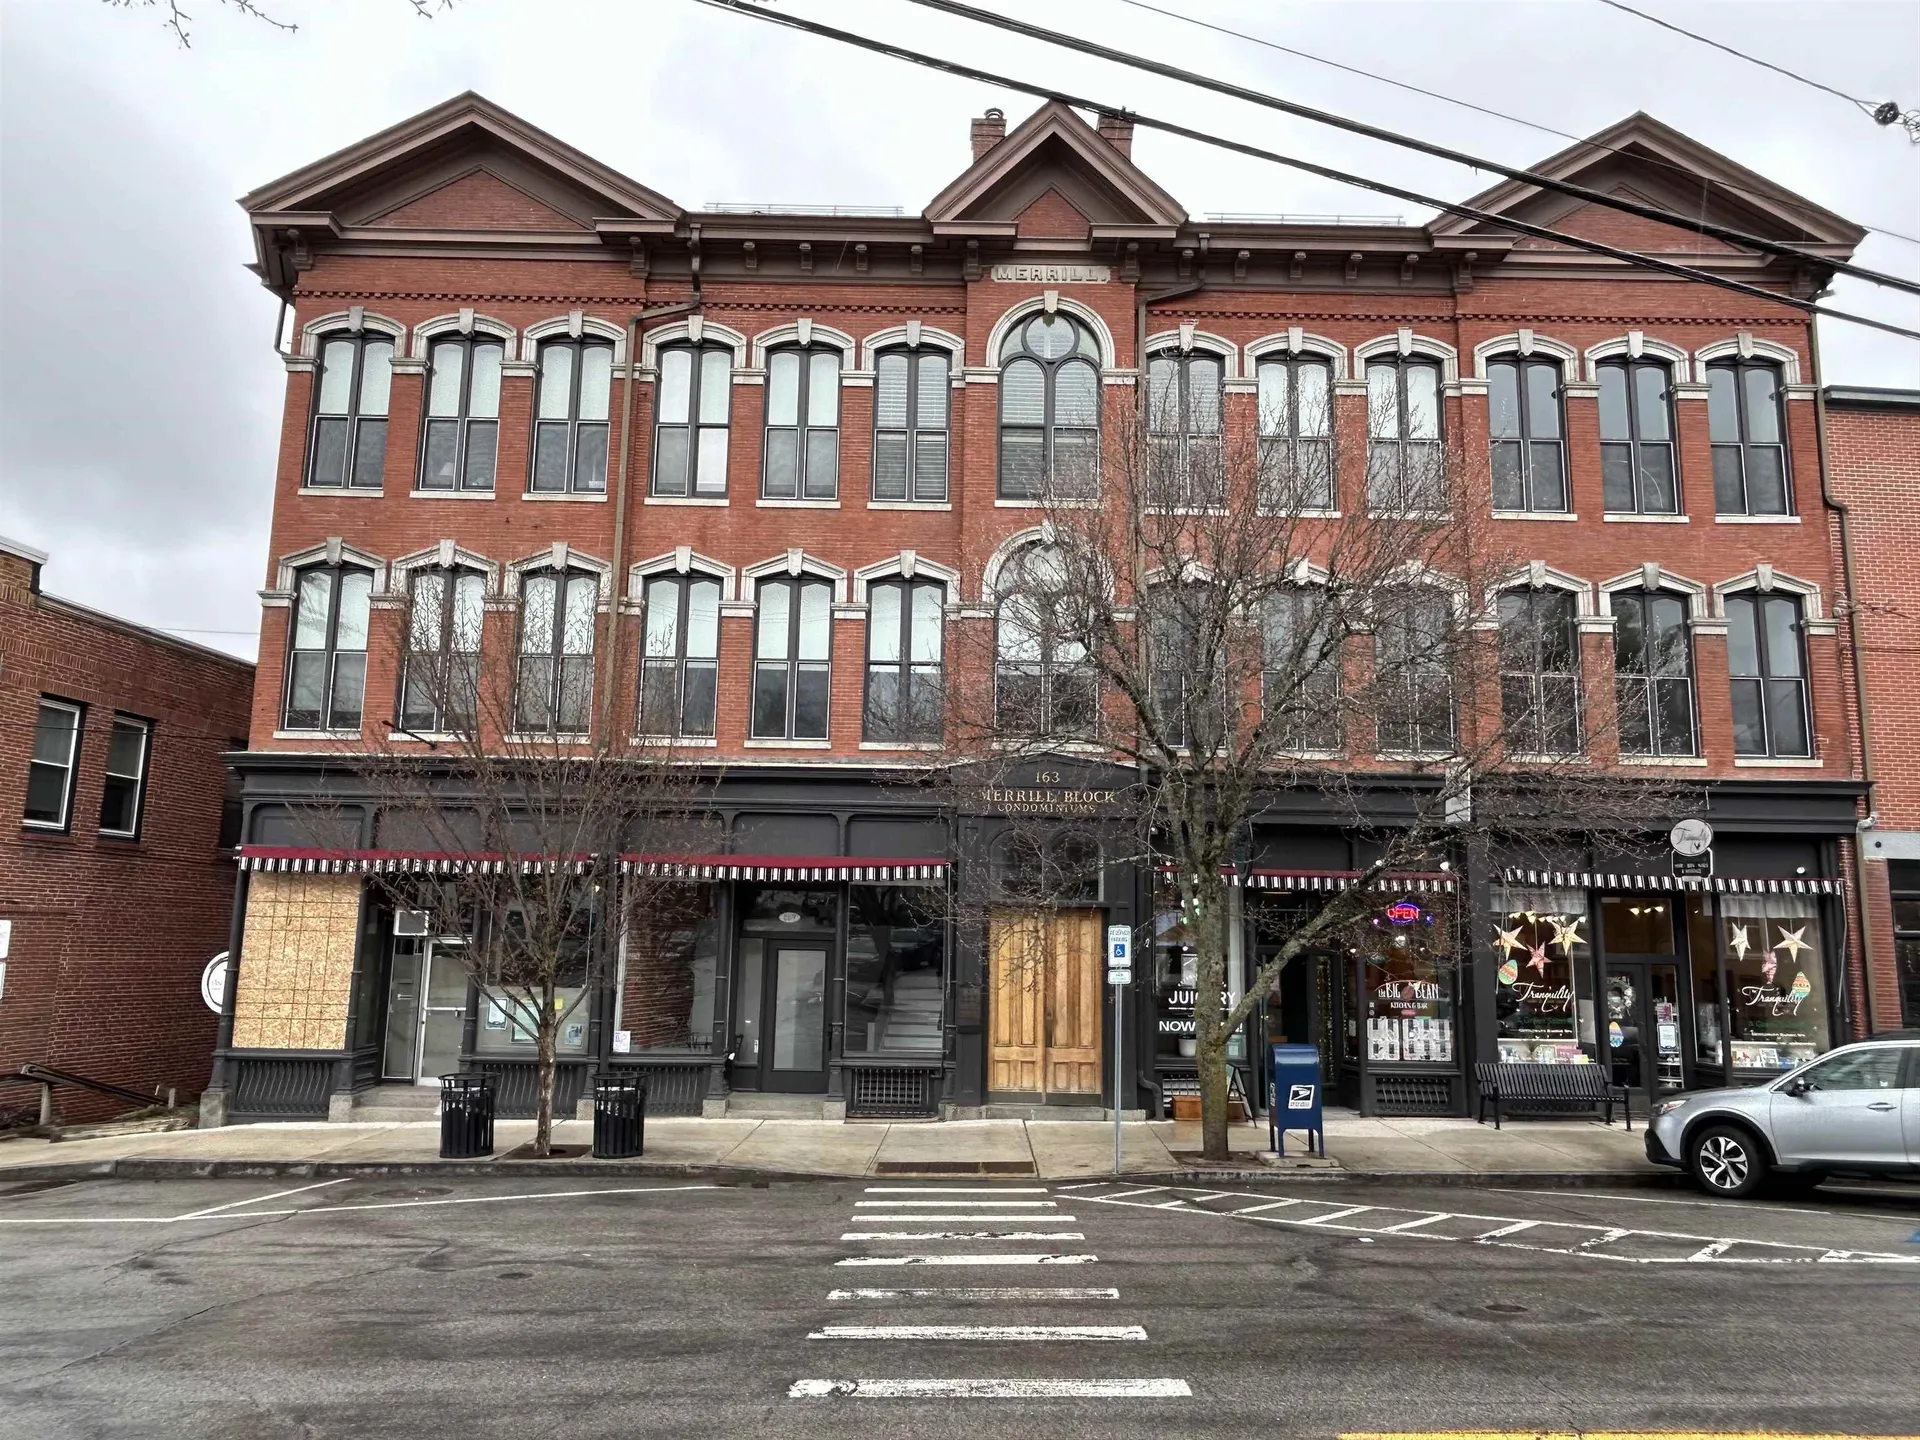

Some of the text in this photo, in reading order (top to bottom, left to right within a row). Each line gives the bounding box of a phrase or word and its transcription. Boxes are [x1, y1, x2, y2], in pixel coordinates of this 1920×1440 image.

[1035, 771, 1060, 783] 163
[981, 789, 1116, 803] MERRILL BLOCK
[997, 803, 1096, 813] CONDOMINIUMS
[1387, 907, 1419, 919] OPEN
[1168, 990, 1236, 1005] JUIRY
[1385, 982, 1401, 998] BIG
[1414, 983, 1439, 999] BEAN
[1512, 982, 1575, 1013] Tranquility
[1742, 986, 1805, 1017] Tranquility
[1159, 1020, 1196, 1032] NOW
